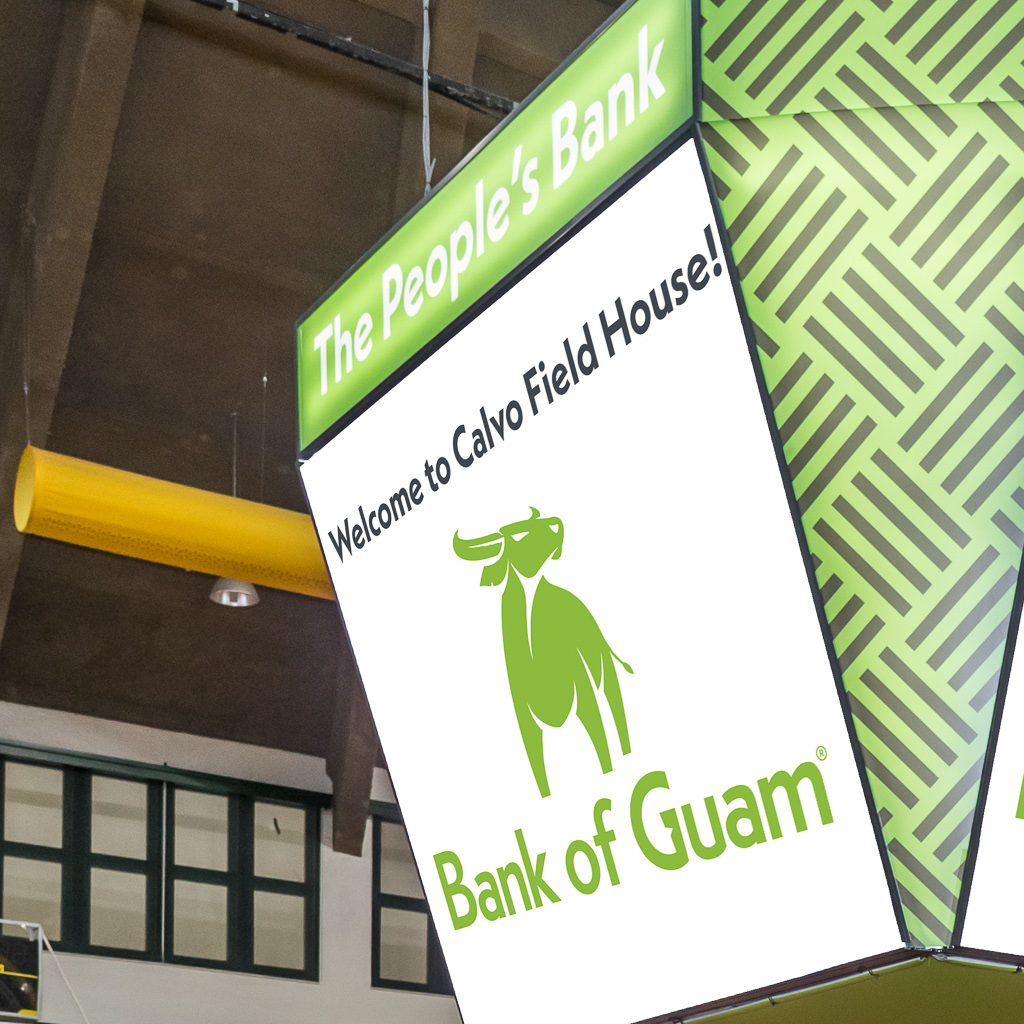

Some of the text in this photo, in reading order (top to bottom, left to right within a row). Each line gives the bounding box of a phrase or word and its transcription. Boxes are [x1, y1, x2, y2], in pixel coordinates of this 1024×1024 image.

[313, 314, 374, 396] The
[552, 24, 667, 191] Bank
[328, 224, 723, 562] Welcome to Calvo Field House!
[433, 828, 562, 931] Bank
[566, 798, 621, 895] of
